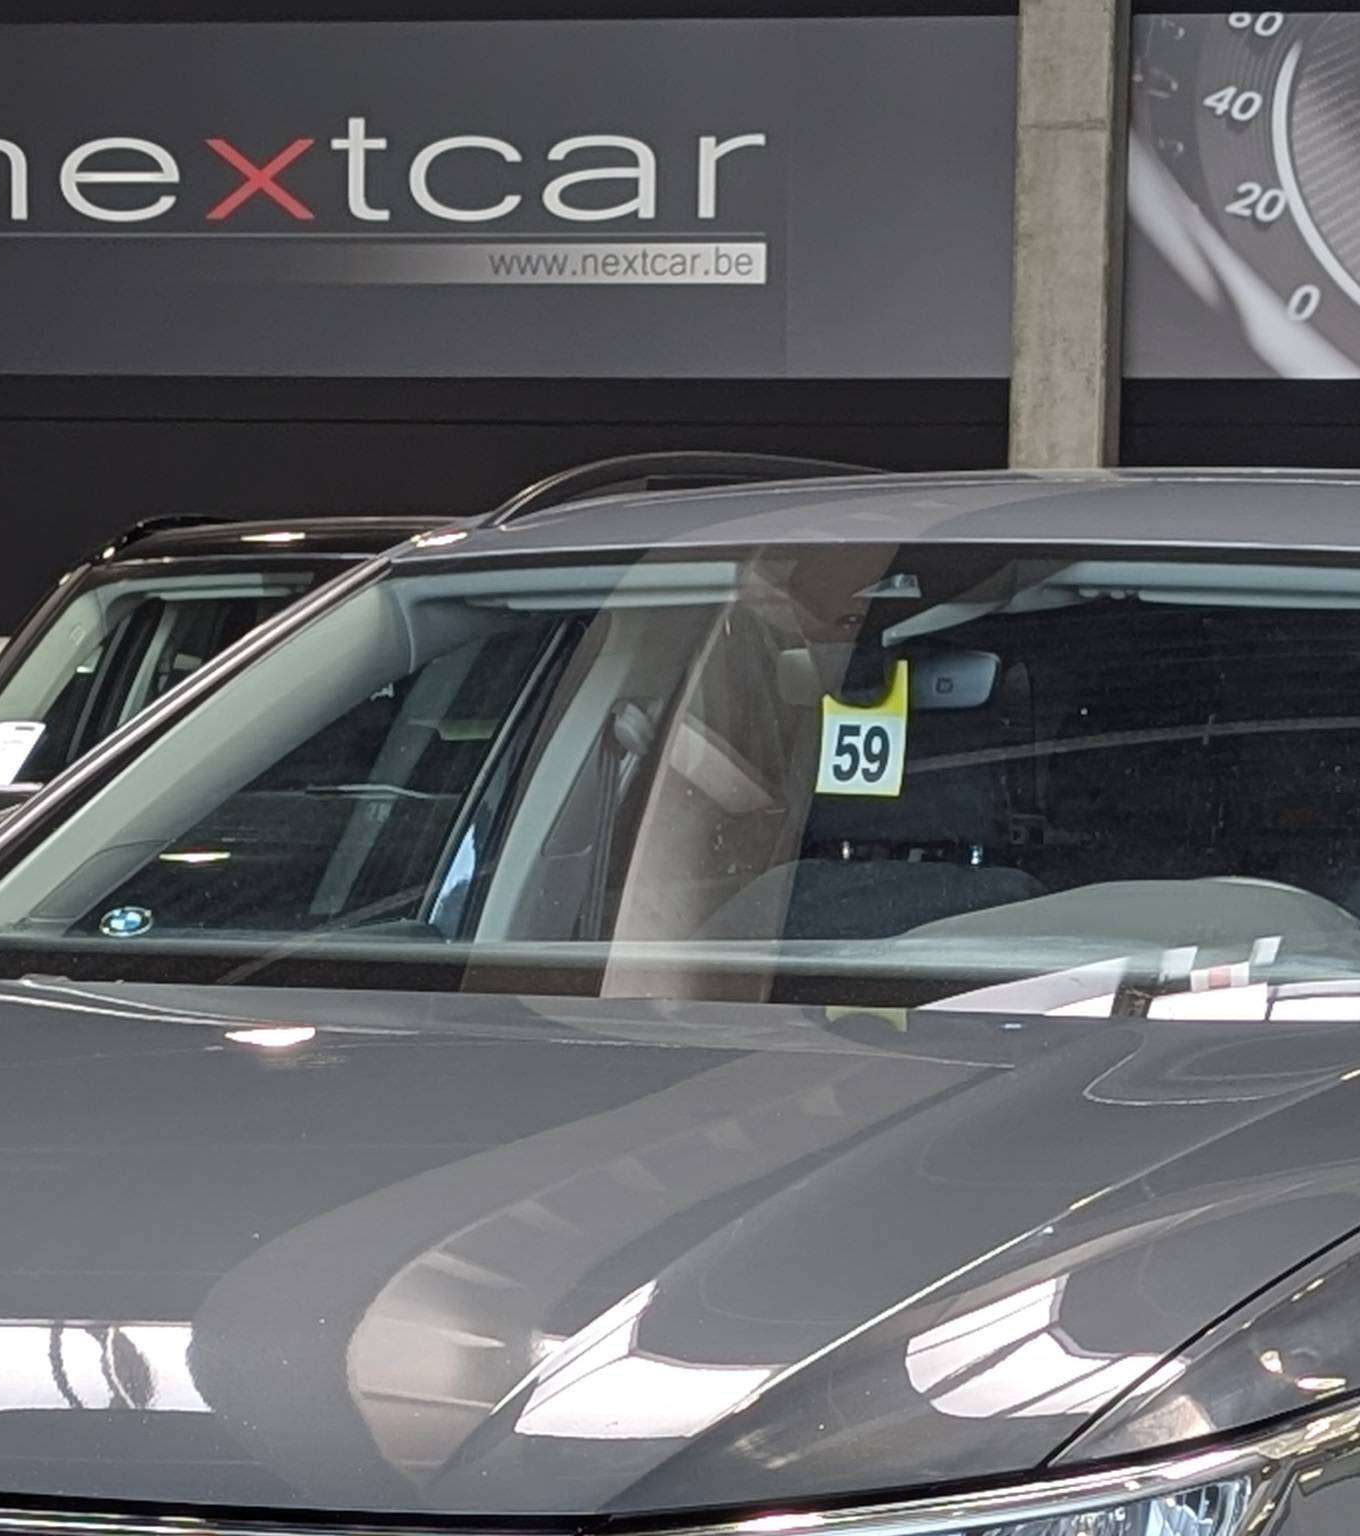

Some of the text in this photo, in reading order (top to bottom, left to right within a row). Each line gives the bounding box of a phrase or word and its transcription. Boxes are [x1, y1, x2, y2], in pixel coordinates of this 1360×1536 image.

[1203, 86, 1263, 121] 40
[1225, 181, 1287, 223] 20
[489, 247, 754, 278] www.nextcar.be
[1287, 285, 1321, 323] 0
[832, 724, 890, 783] 59
